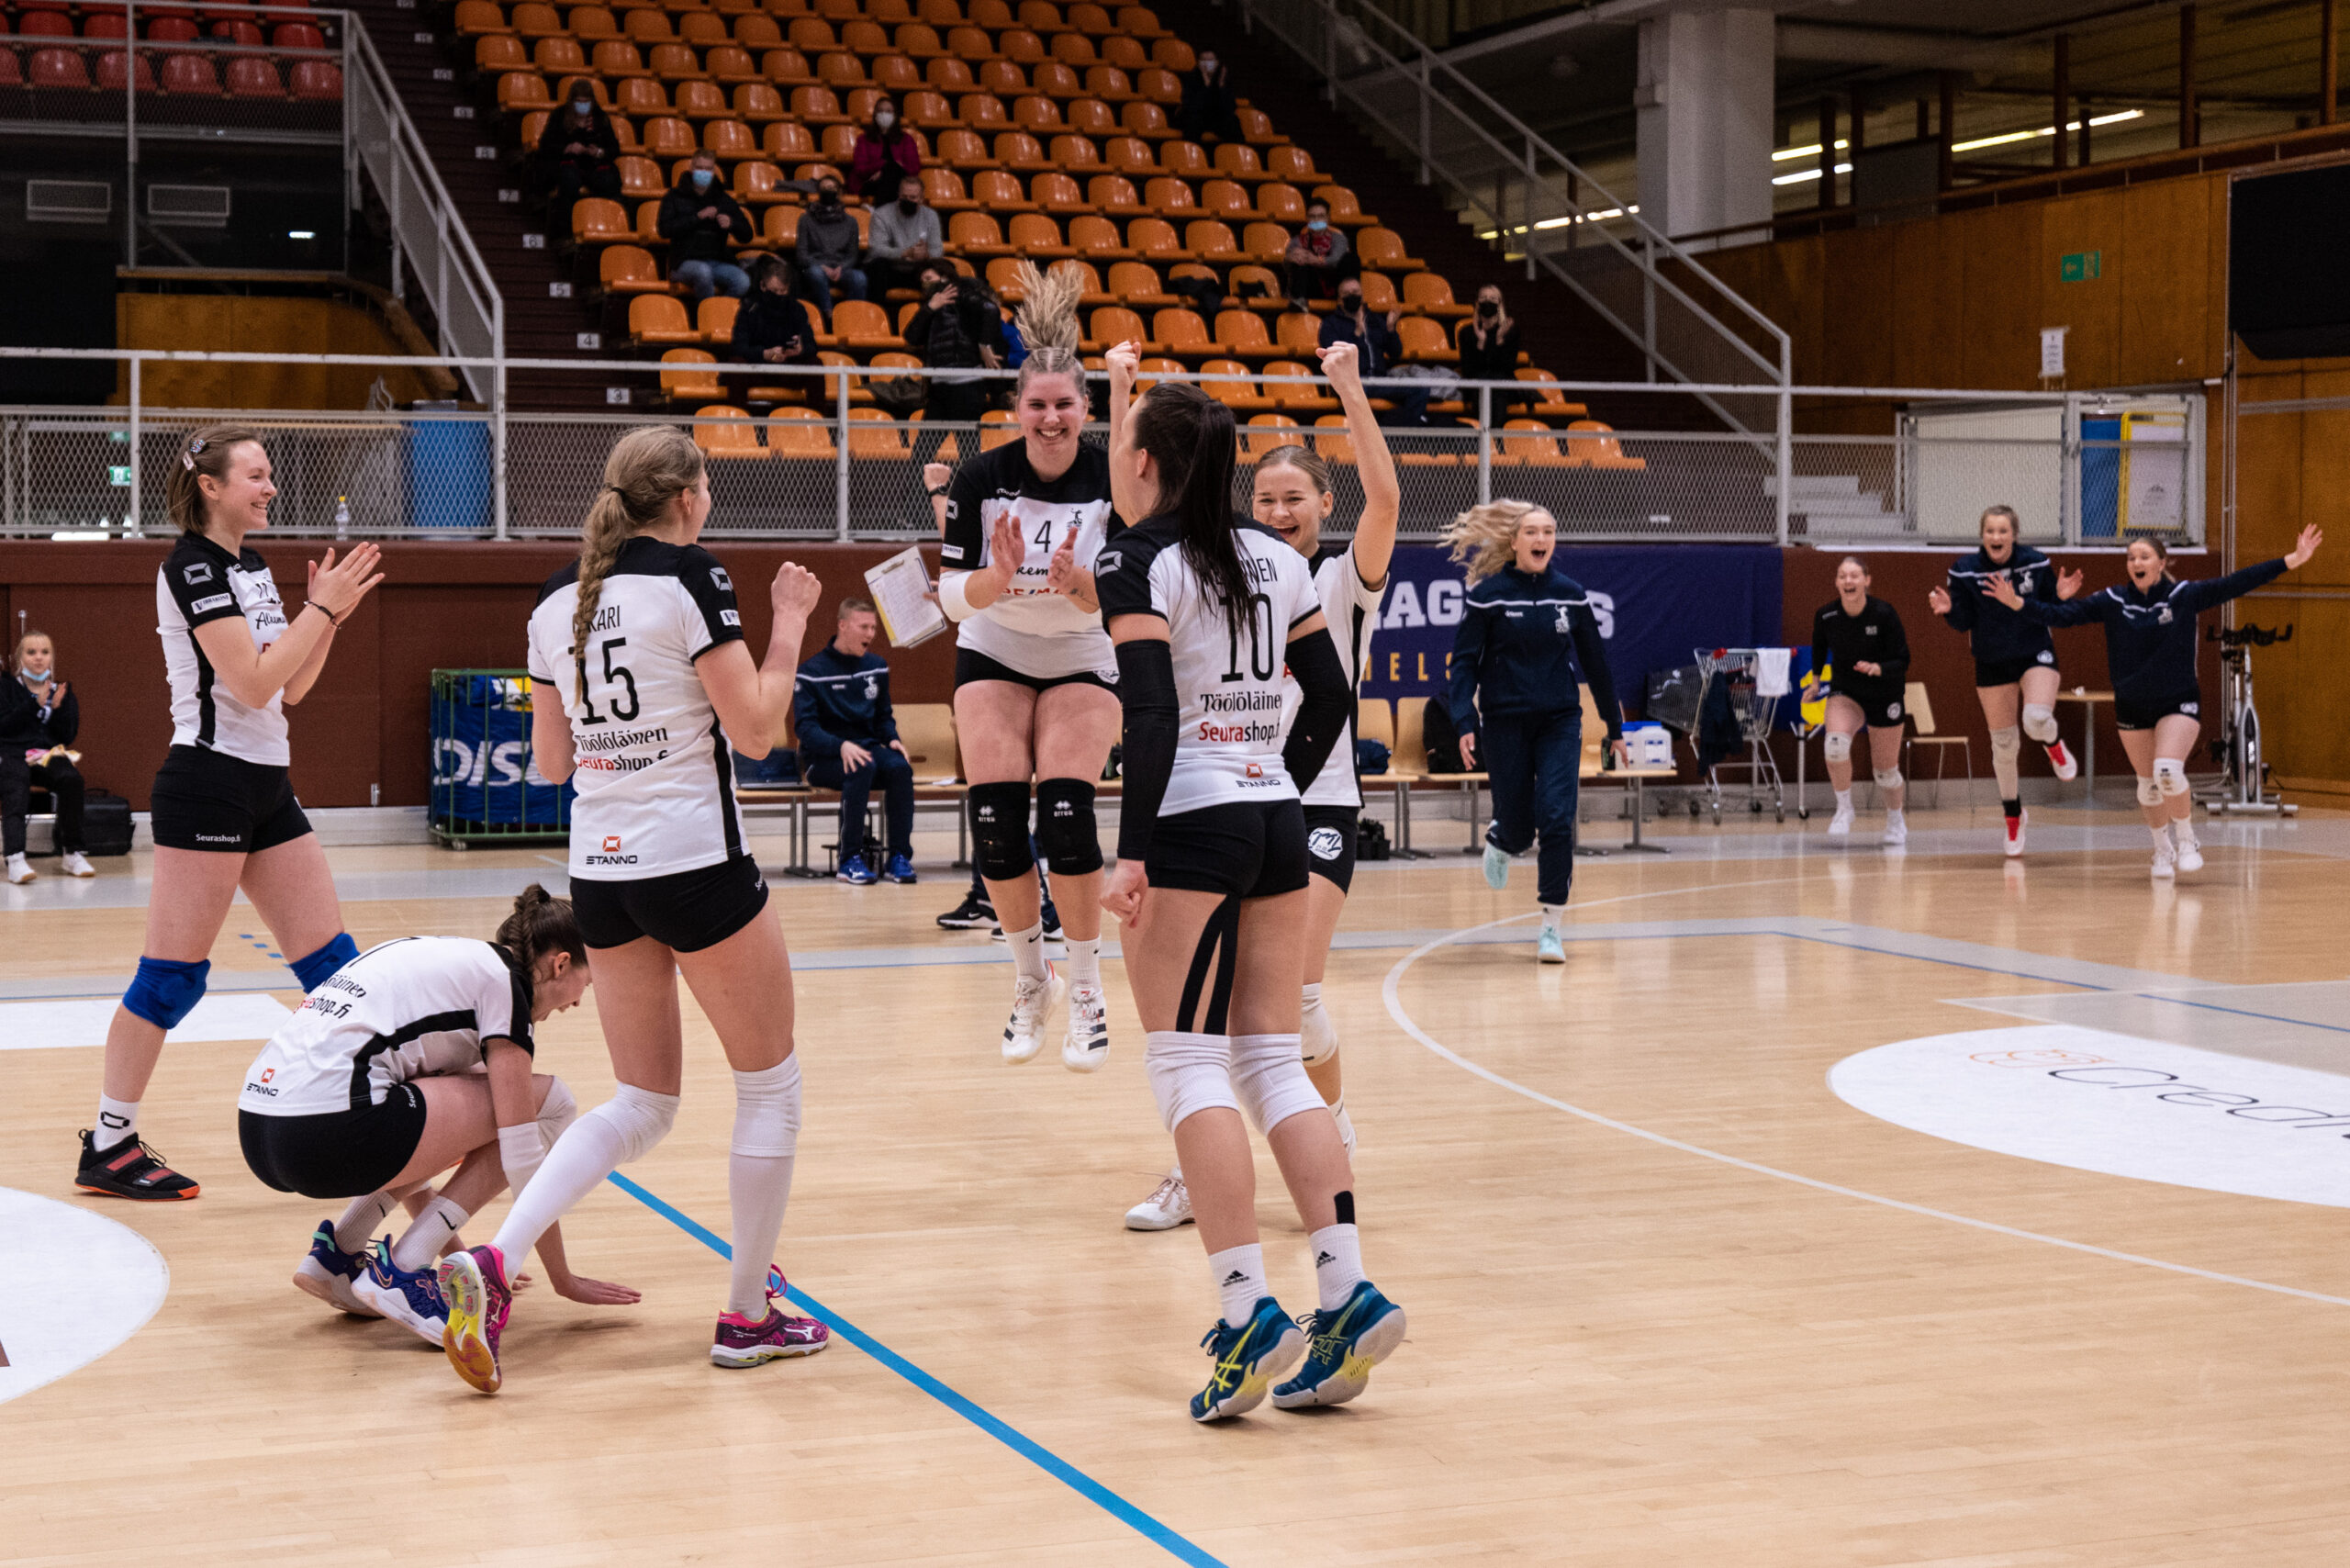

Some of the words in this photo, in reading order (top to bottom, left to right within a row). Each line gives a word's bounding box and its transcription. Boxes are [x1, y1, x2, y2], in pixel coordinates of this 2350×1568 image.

[583, 334, 593, 347] 4
[1034, 520, 1052, 554] 4
[1219, 593, 1274, 683] 10
[568, 636, 640, 726] 15
[1200, 690, 1283, 713] Töölöläine
[196, 833, 241, 844] Seurashop.fi
[586, 855, 639, 865] STANNO
[246, 1082, 279, 1097] STANNO
